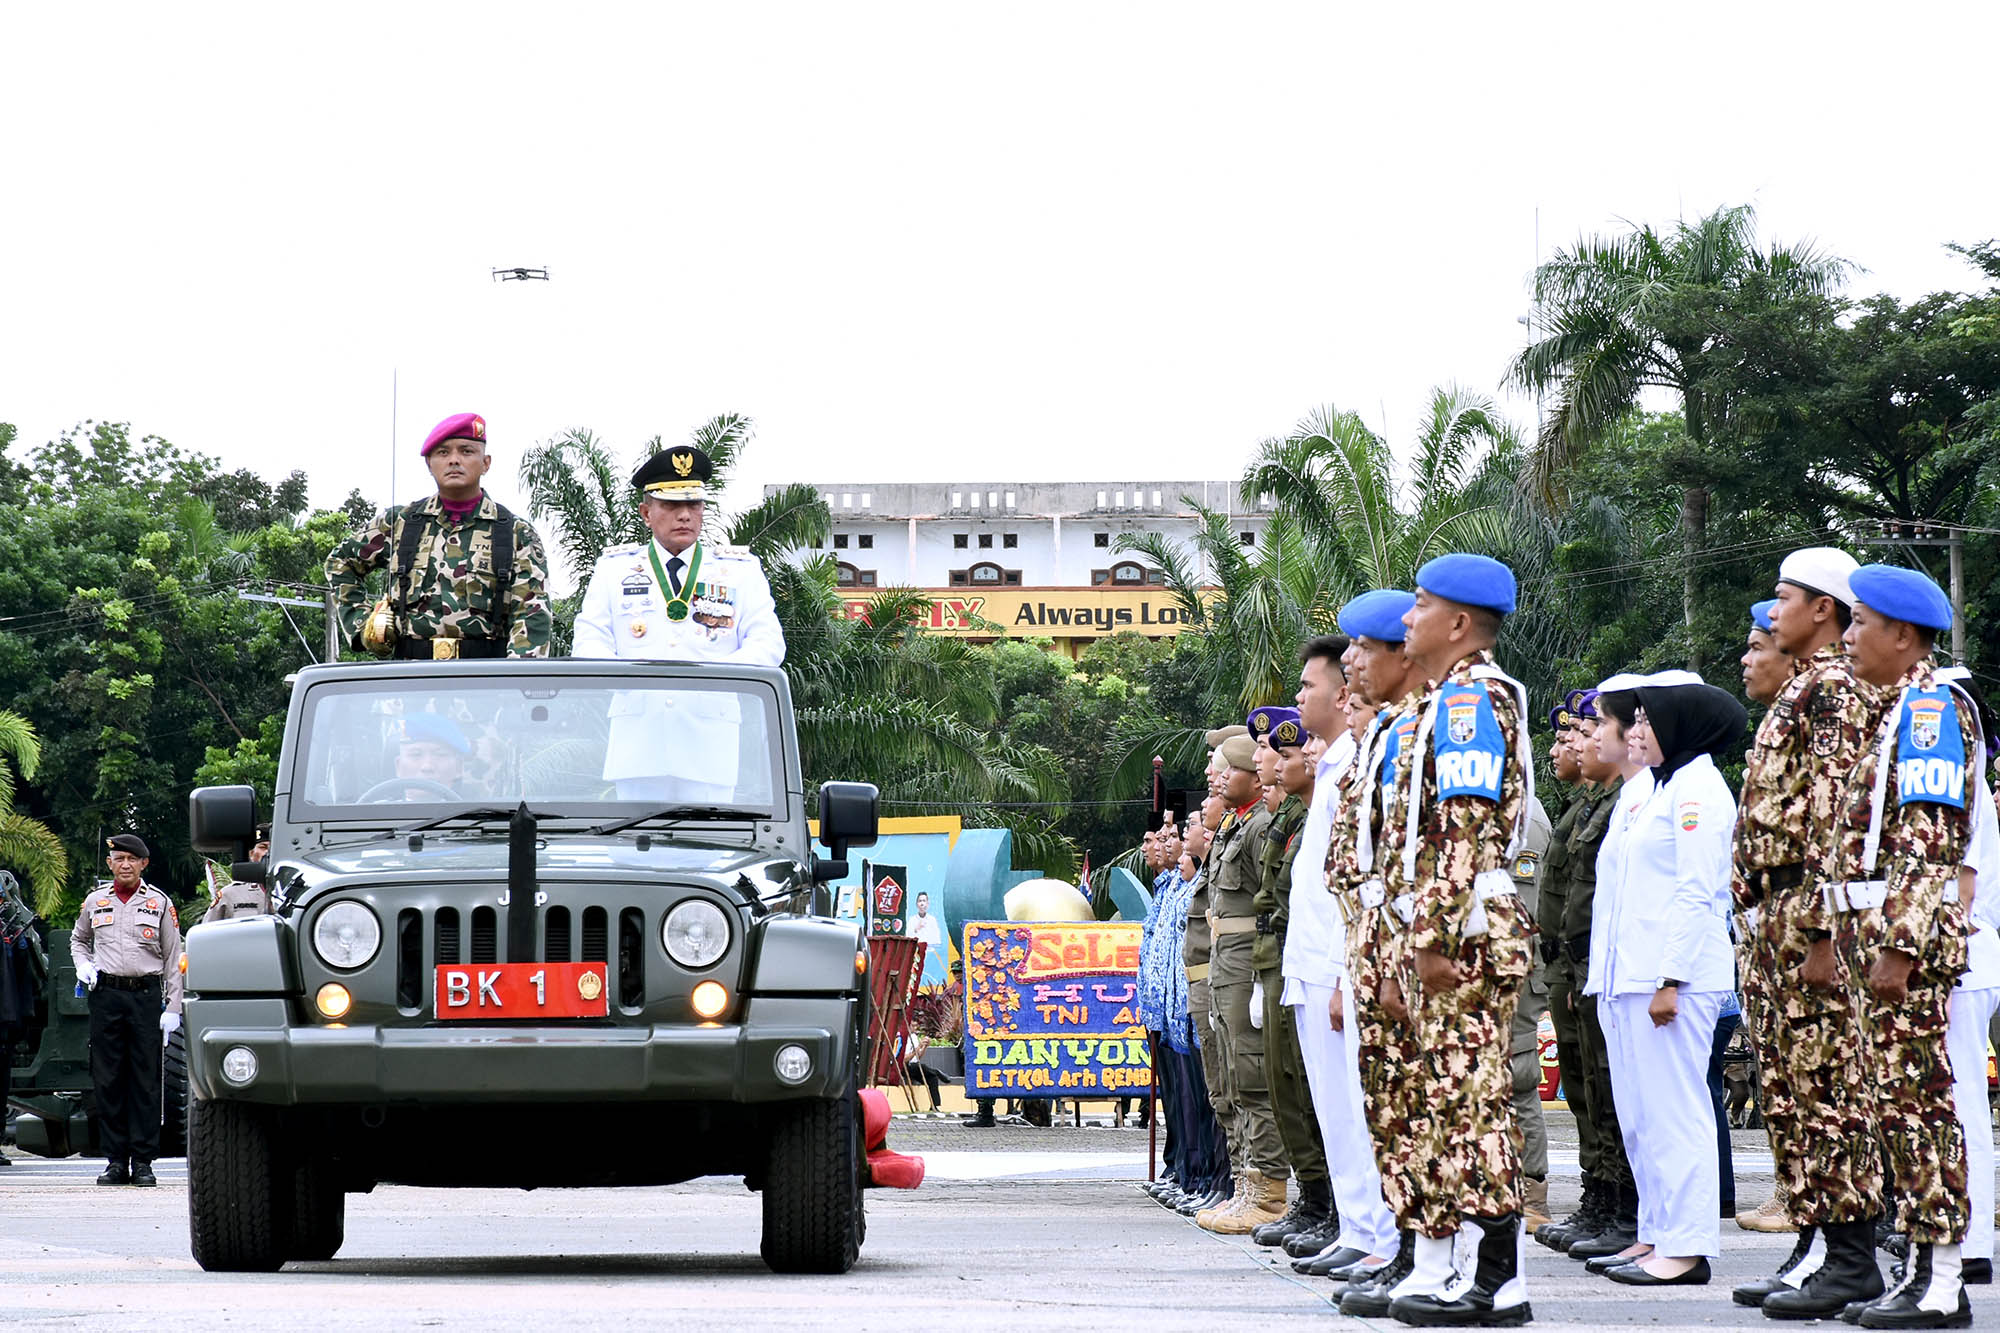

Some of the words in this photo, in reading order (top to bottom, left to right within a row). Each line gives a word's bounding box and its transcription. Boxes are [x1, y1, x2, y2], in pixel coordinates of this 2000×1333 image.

[1014, 602, 1132, 632] Always
[1434, 750, 1503, 791] PROV
[1897, 758, 1965, 800] PROV
[137, 907, 160, 917] POLRI
[497, 889, 549, 907] Jp
[446, 971, 503, 1007] BK
[529, 970, 545, 1006] 1
[1035, 1004, 1089, 1025] TNI
[973, 1039, 1152, 1069] DANYON
[976, 1068, 1055, 1091] LETKOL
